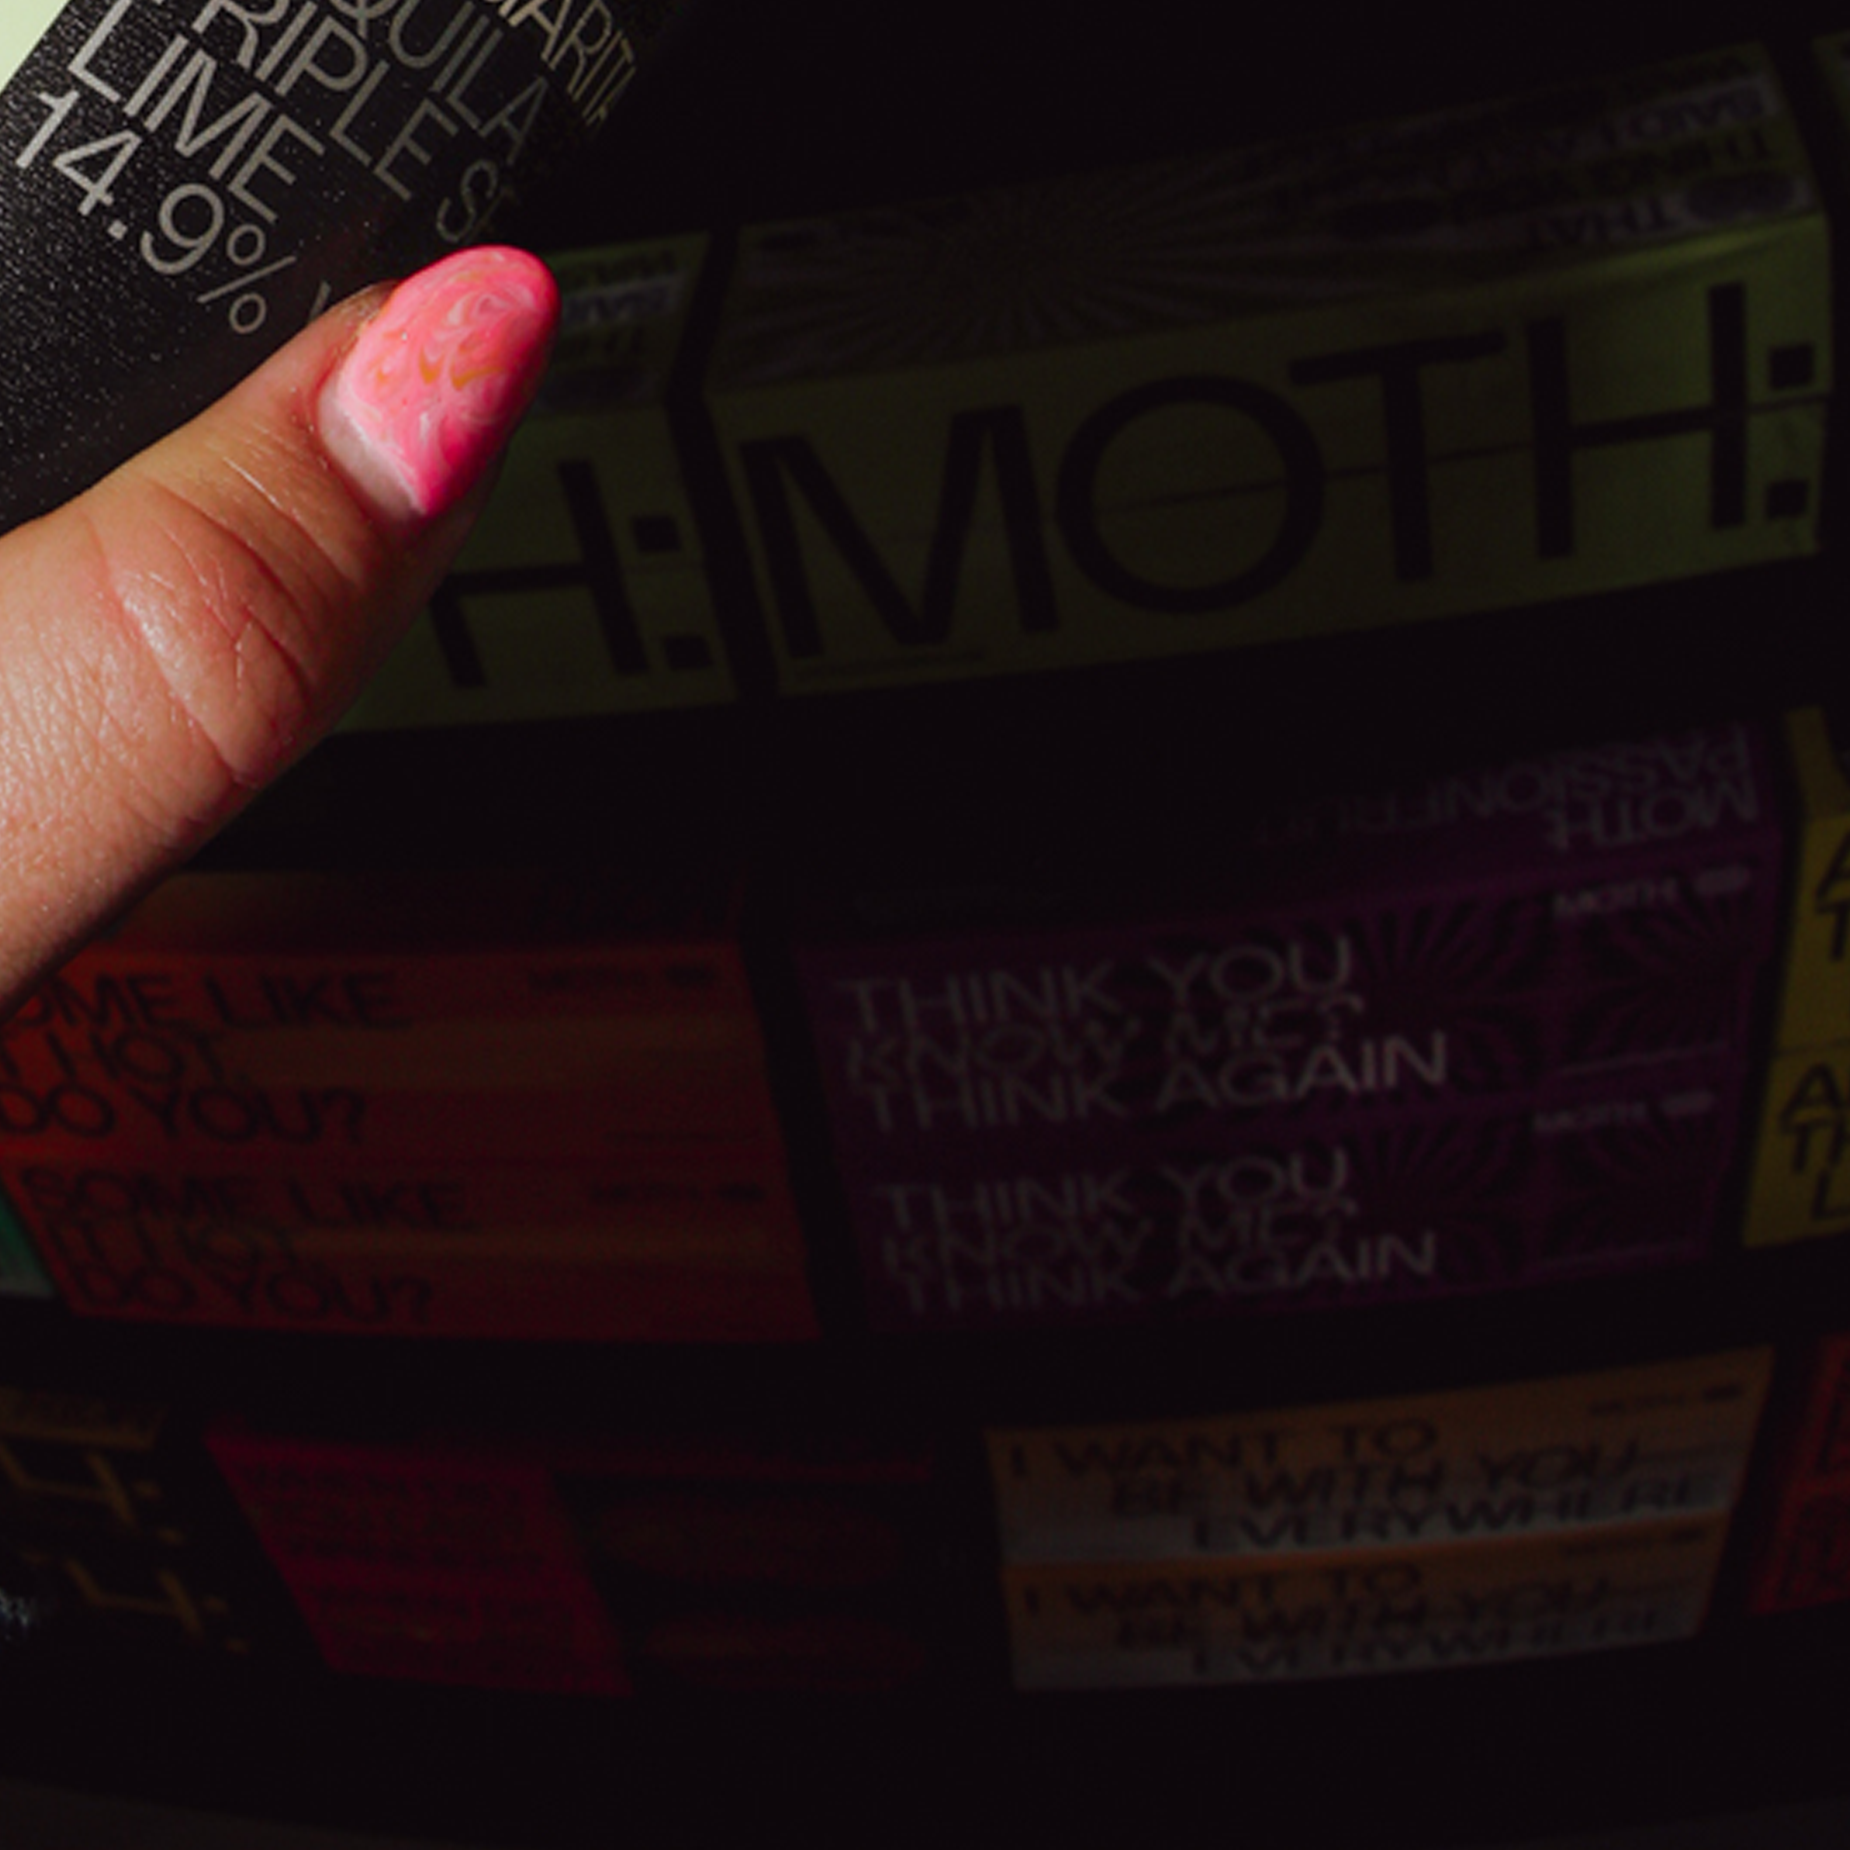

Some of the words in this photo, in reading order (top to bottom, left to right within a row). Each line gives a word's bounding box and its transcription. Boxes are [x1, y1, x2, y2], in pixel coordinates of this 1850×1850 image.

[15, 88, 297, 336] 14.9%
[739, 282, 1814, 660] MOTH:
[205, 972, 412, 1032] LIKE
[835, 958, 1124, 1035] THINK
[1148, 934, 1354, 1008] YOU
[860, 1070, 1128, 1133] THINK
[1154, 1029, 1448, 1115] AGAIN
[872, 1168, 1135, 1233] THINK
[1155, 1145, 1349, 1206] YOU
[892, 1262, 1143, 1313] THINK
[1167, 1228, 1436, 1299] AGAIN
[1058, 1430, 1284, 1476] WANT
[1330, 1416, 1439, 1456] TO
[1247, 1458, 1446, 1510] WITH
[1476, 1438, 1642, 1492] YOU
[1062, 1574, 1278, 1614] WANT
[1322, 1561, 1423, 1594] TO
[1242, 1596, 1428, 1641] WITH
[1454, 1576, 1612, 1622] YOU
